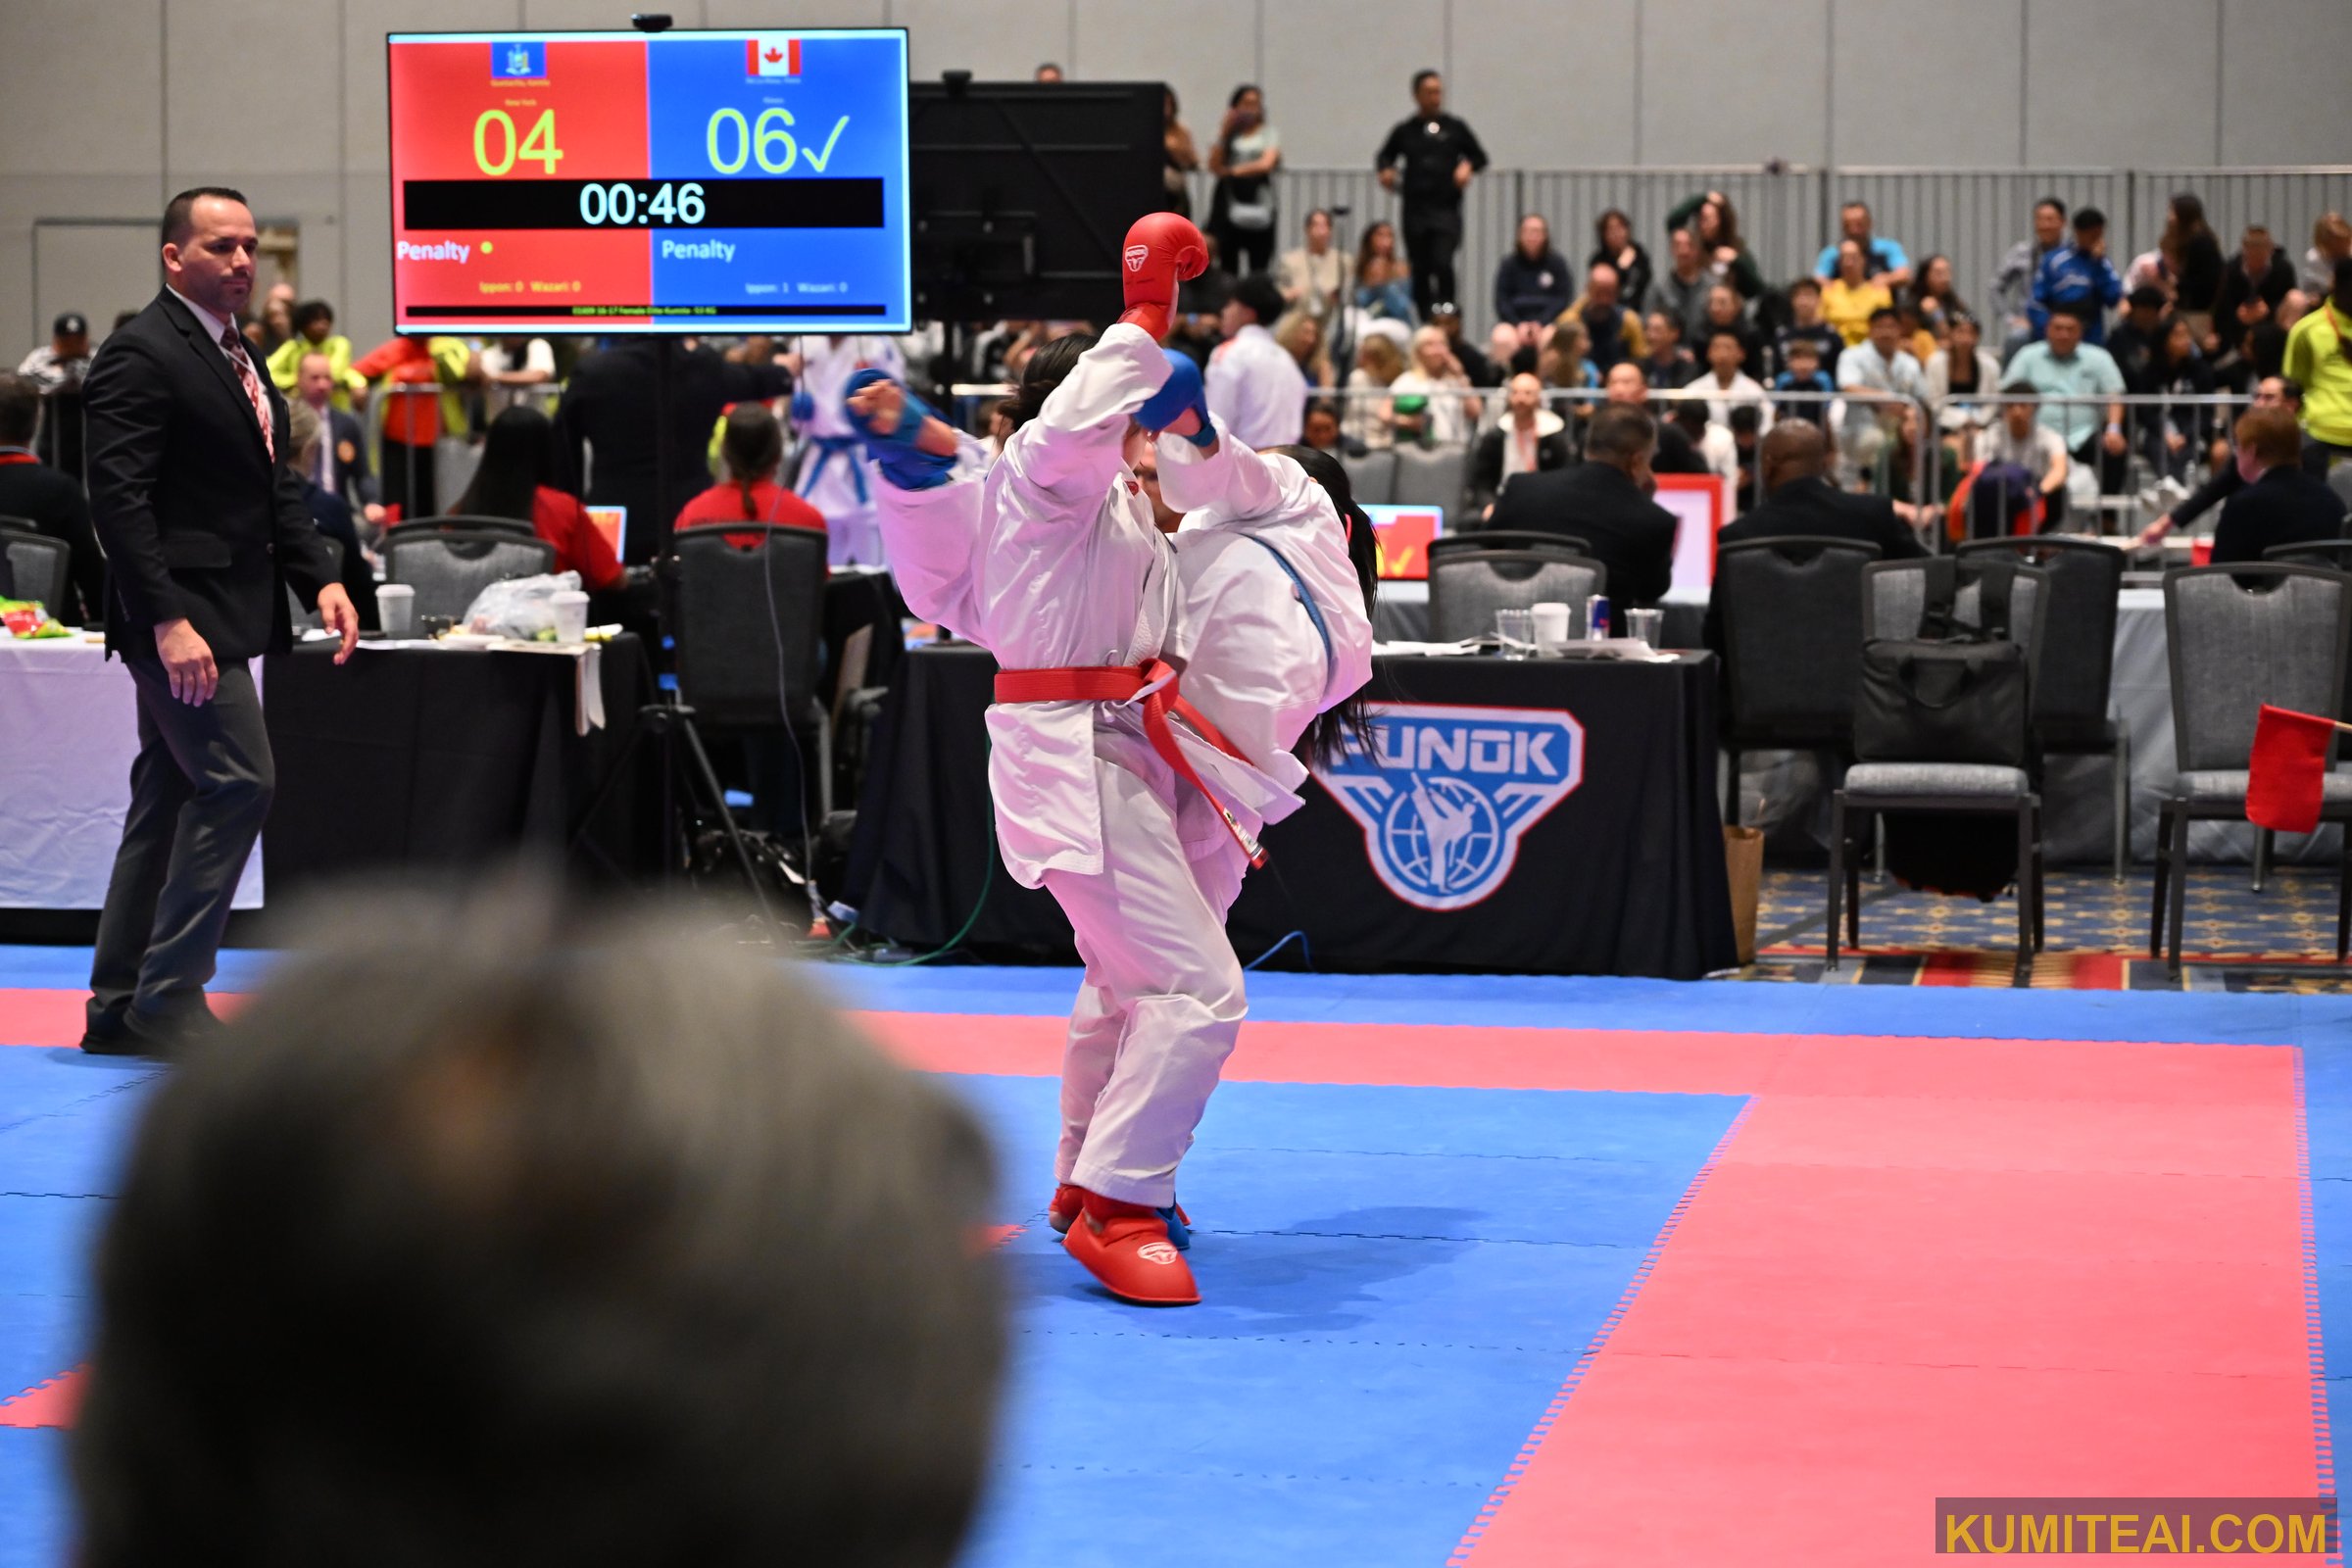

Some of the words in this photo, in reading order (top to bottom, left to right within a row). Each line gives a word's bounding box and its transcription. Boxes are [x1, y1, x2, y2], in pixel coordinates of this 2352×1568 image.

[474, 109, 564, 175] 04
[707, 107, 797, 174] 06
[579, 182, 706, 224] 00:46
[397, 240, 470, 264] Penalty
[662, 239, 735, 263] Penalty
